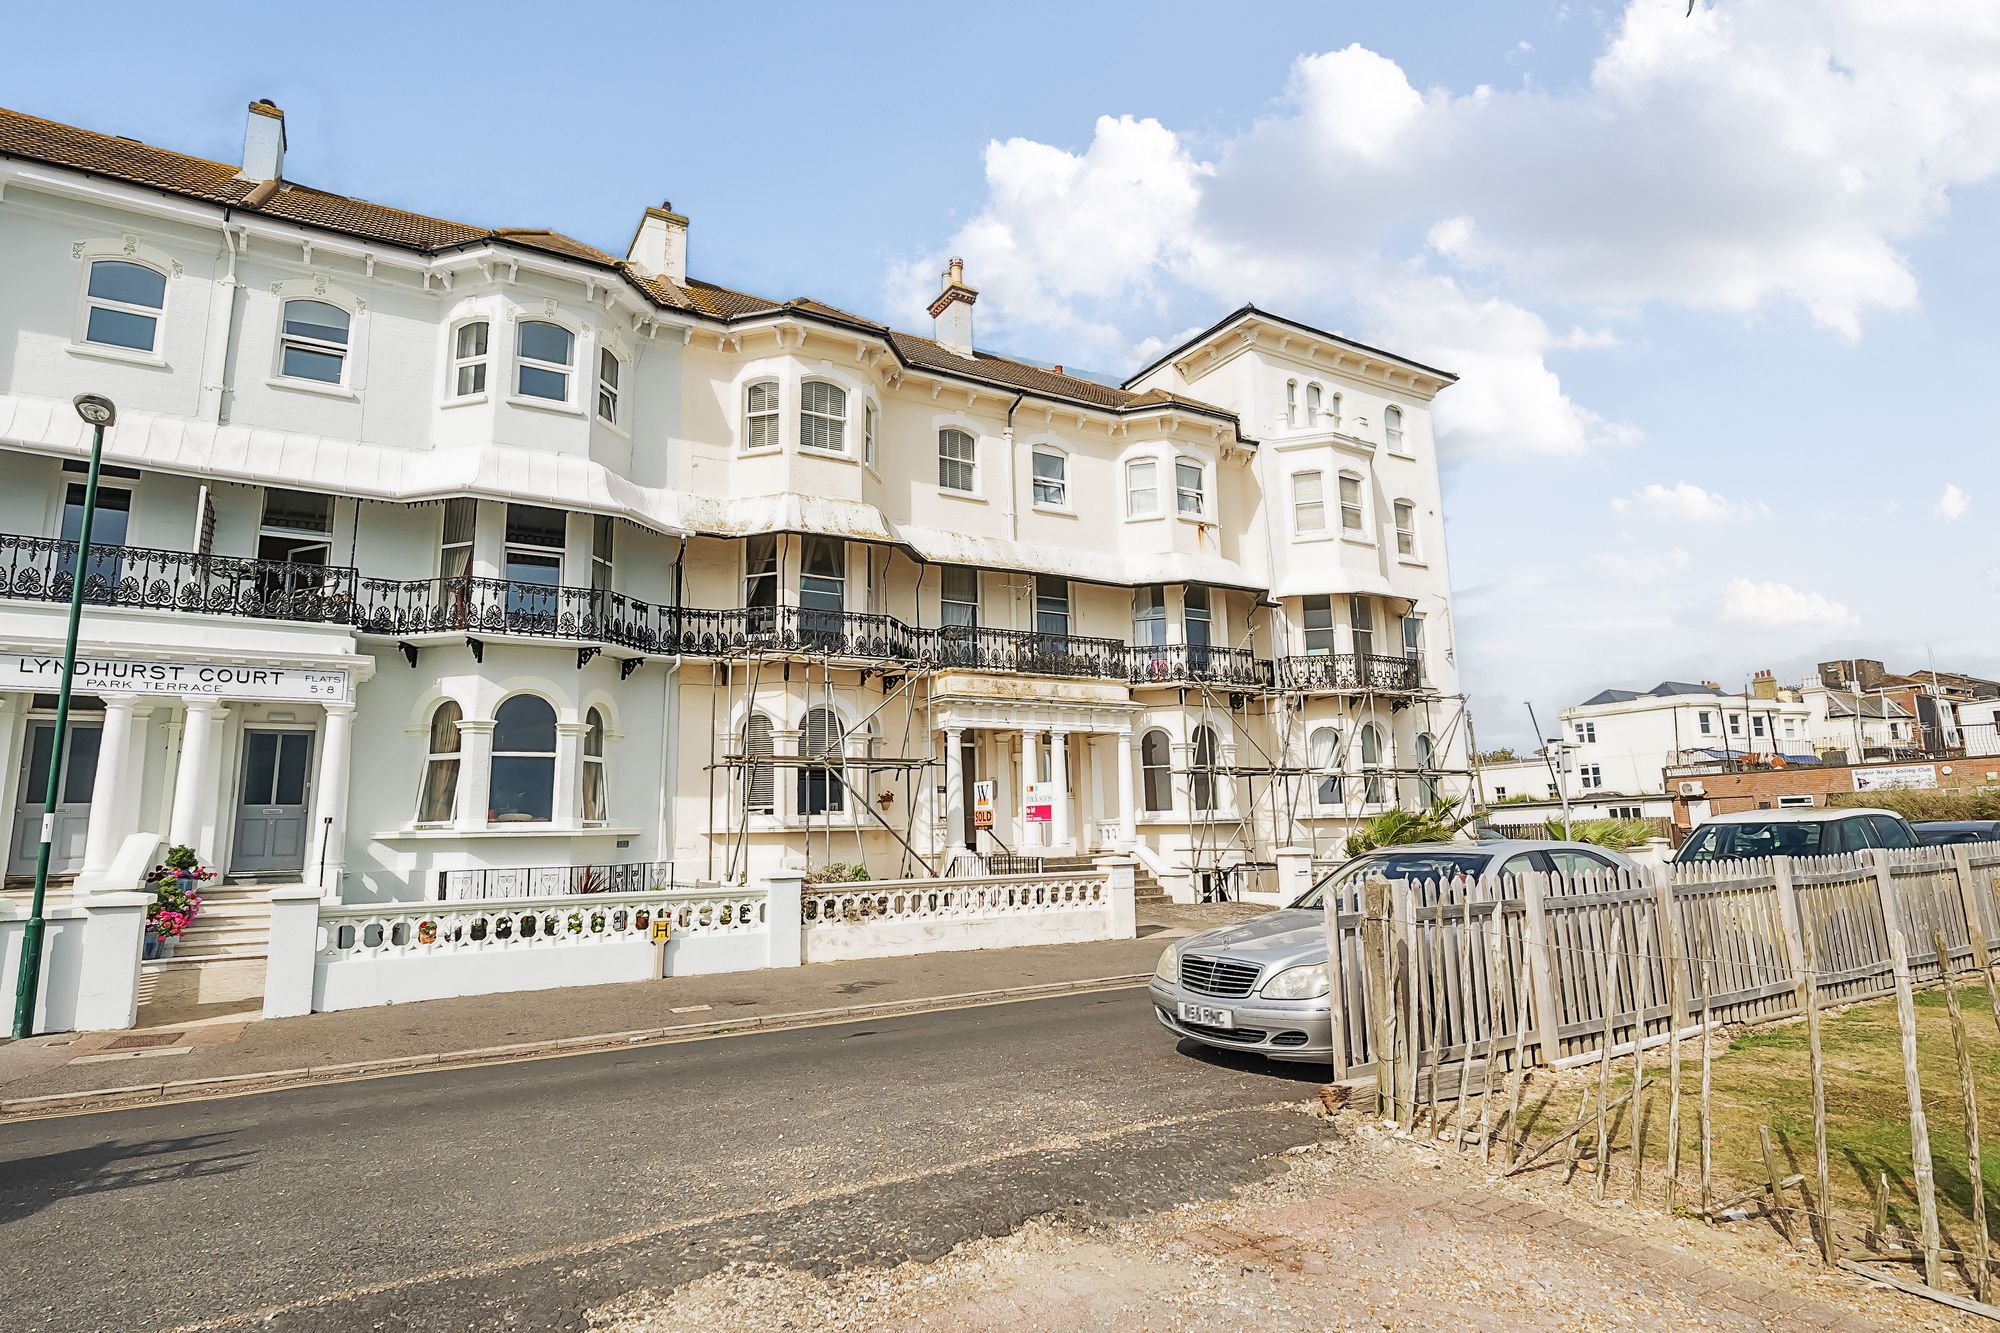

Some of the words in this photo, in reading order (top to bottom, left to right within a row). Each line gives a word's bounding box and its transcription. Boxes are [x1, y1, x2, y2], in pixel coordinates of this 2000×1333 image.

[19, 658, 185, 681] LYNDHURST
[199, 668, 285, 685] COURT
[86, 679, 132, 689] PARK
[143, 681, 223, 693] TERRACE
[305, 675, 341, 683] FLATS
[975, 811, 992, 822] SOLD
[654, 922, 670, 938] H
